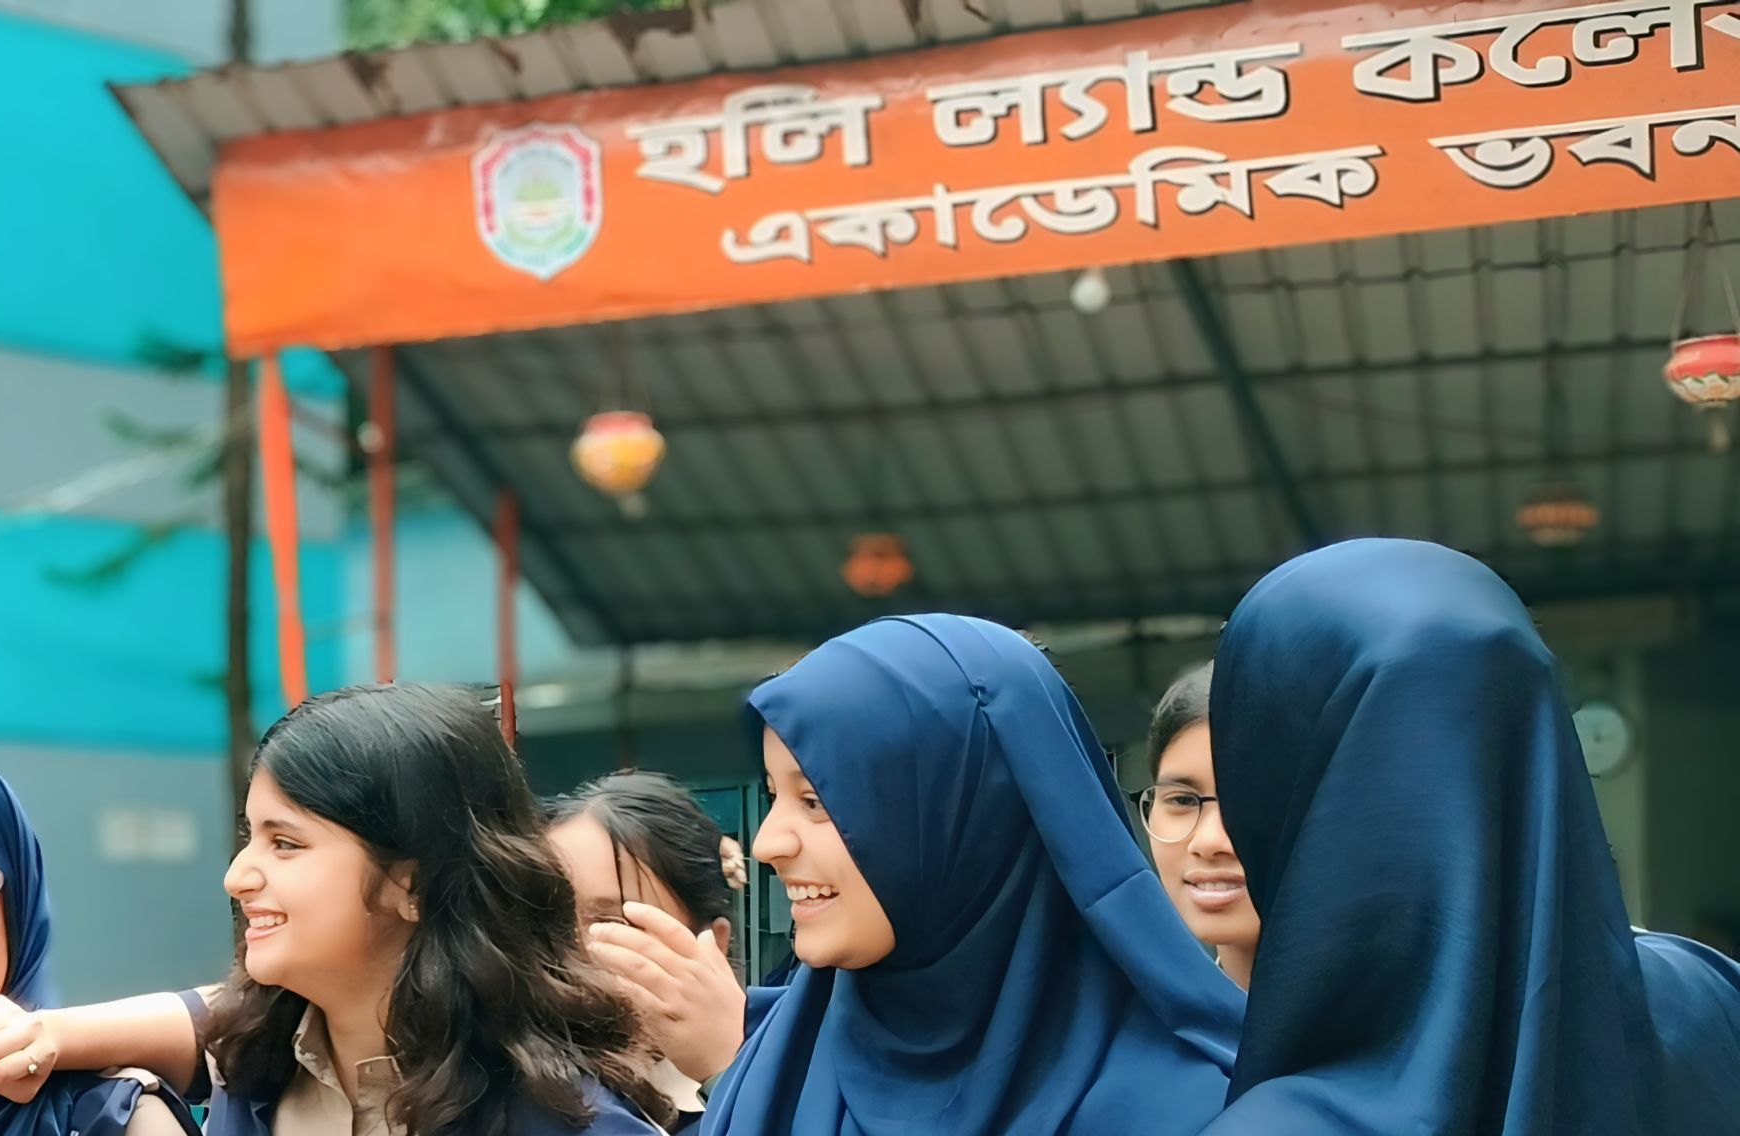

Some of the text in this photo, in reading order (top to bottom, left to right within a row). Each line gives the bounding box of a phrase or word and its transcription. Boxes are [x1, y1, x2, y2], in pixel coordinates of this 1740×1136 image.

[625, 83, 885, 195] হলি
[926, 43, 1302, 146] ল্যান্ড
[721, 144, 1387, 263] একাডেমিক
